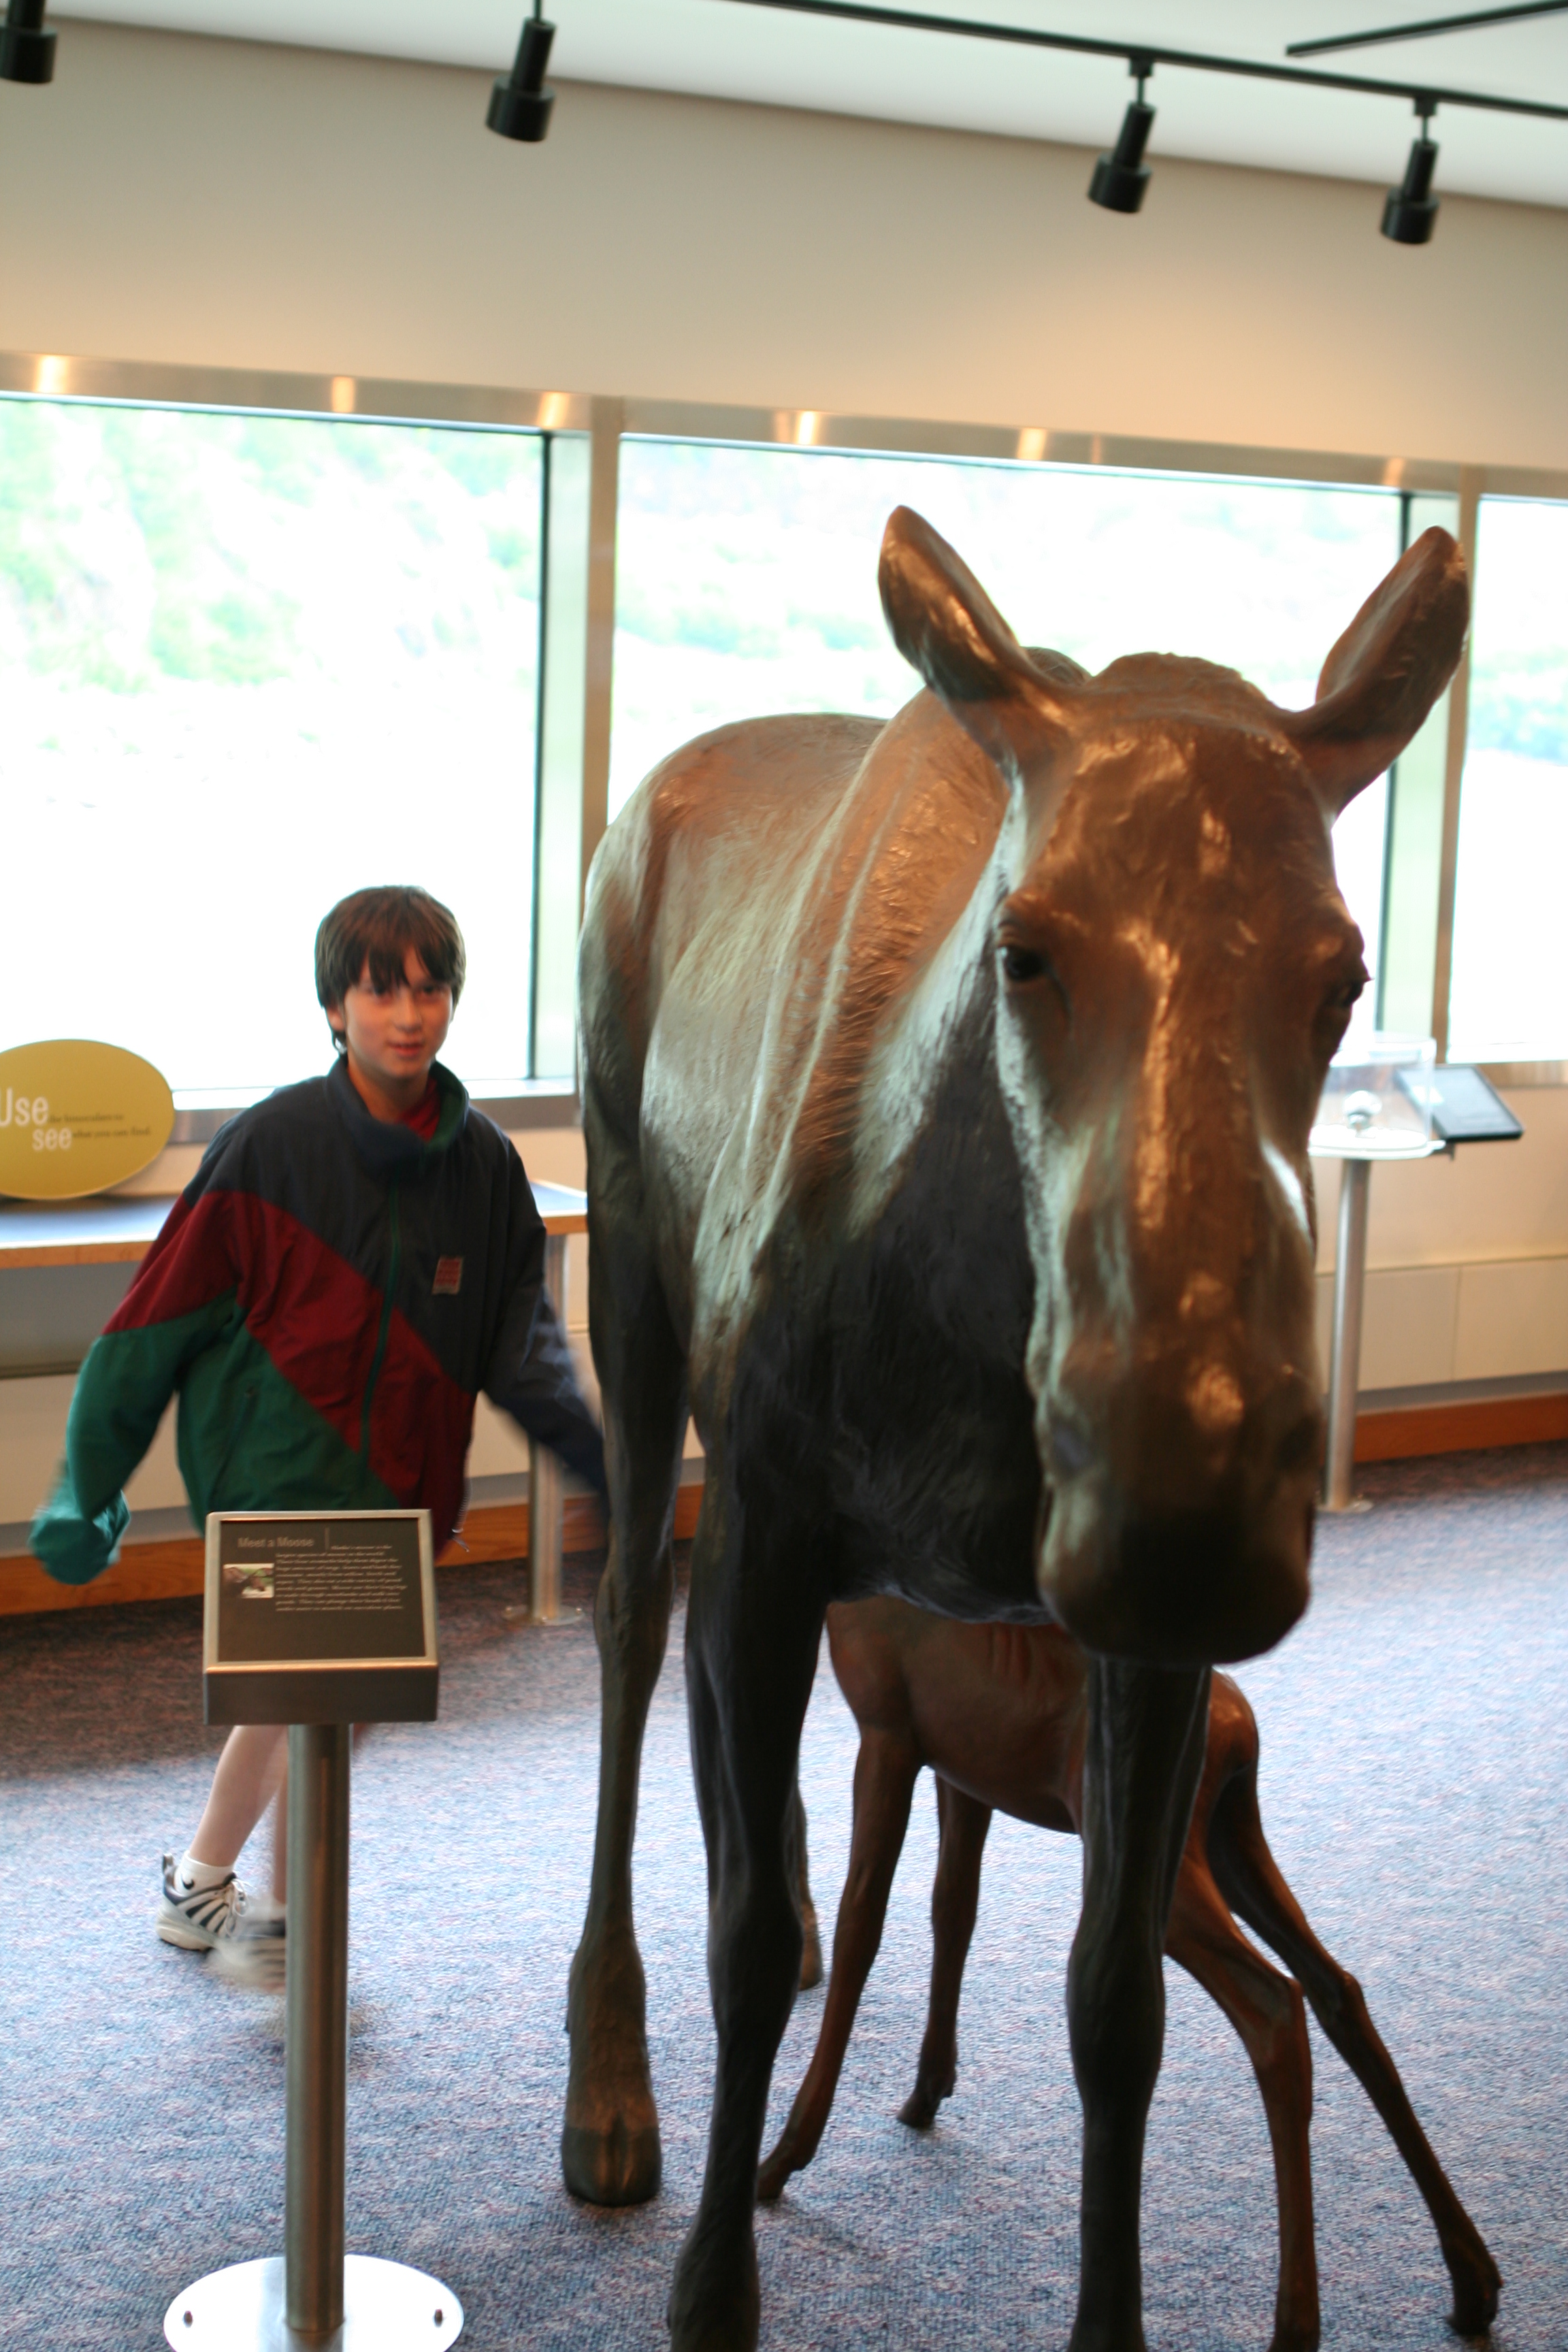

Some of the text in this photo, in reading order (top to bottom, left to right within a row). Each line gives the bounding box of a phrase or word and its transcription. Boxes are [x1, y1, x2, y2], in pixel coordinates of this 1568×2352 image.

[31, 1127, 71, 1151] see
[238, 1536, 314, 1548] Meet a Moose
